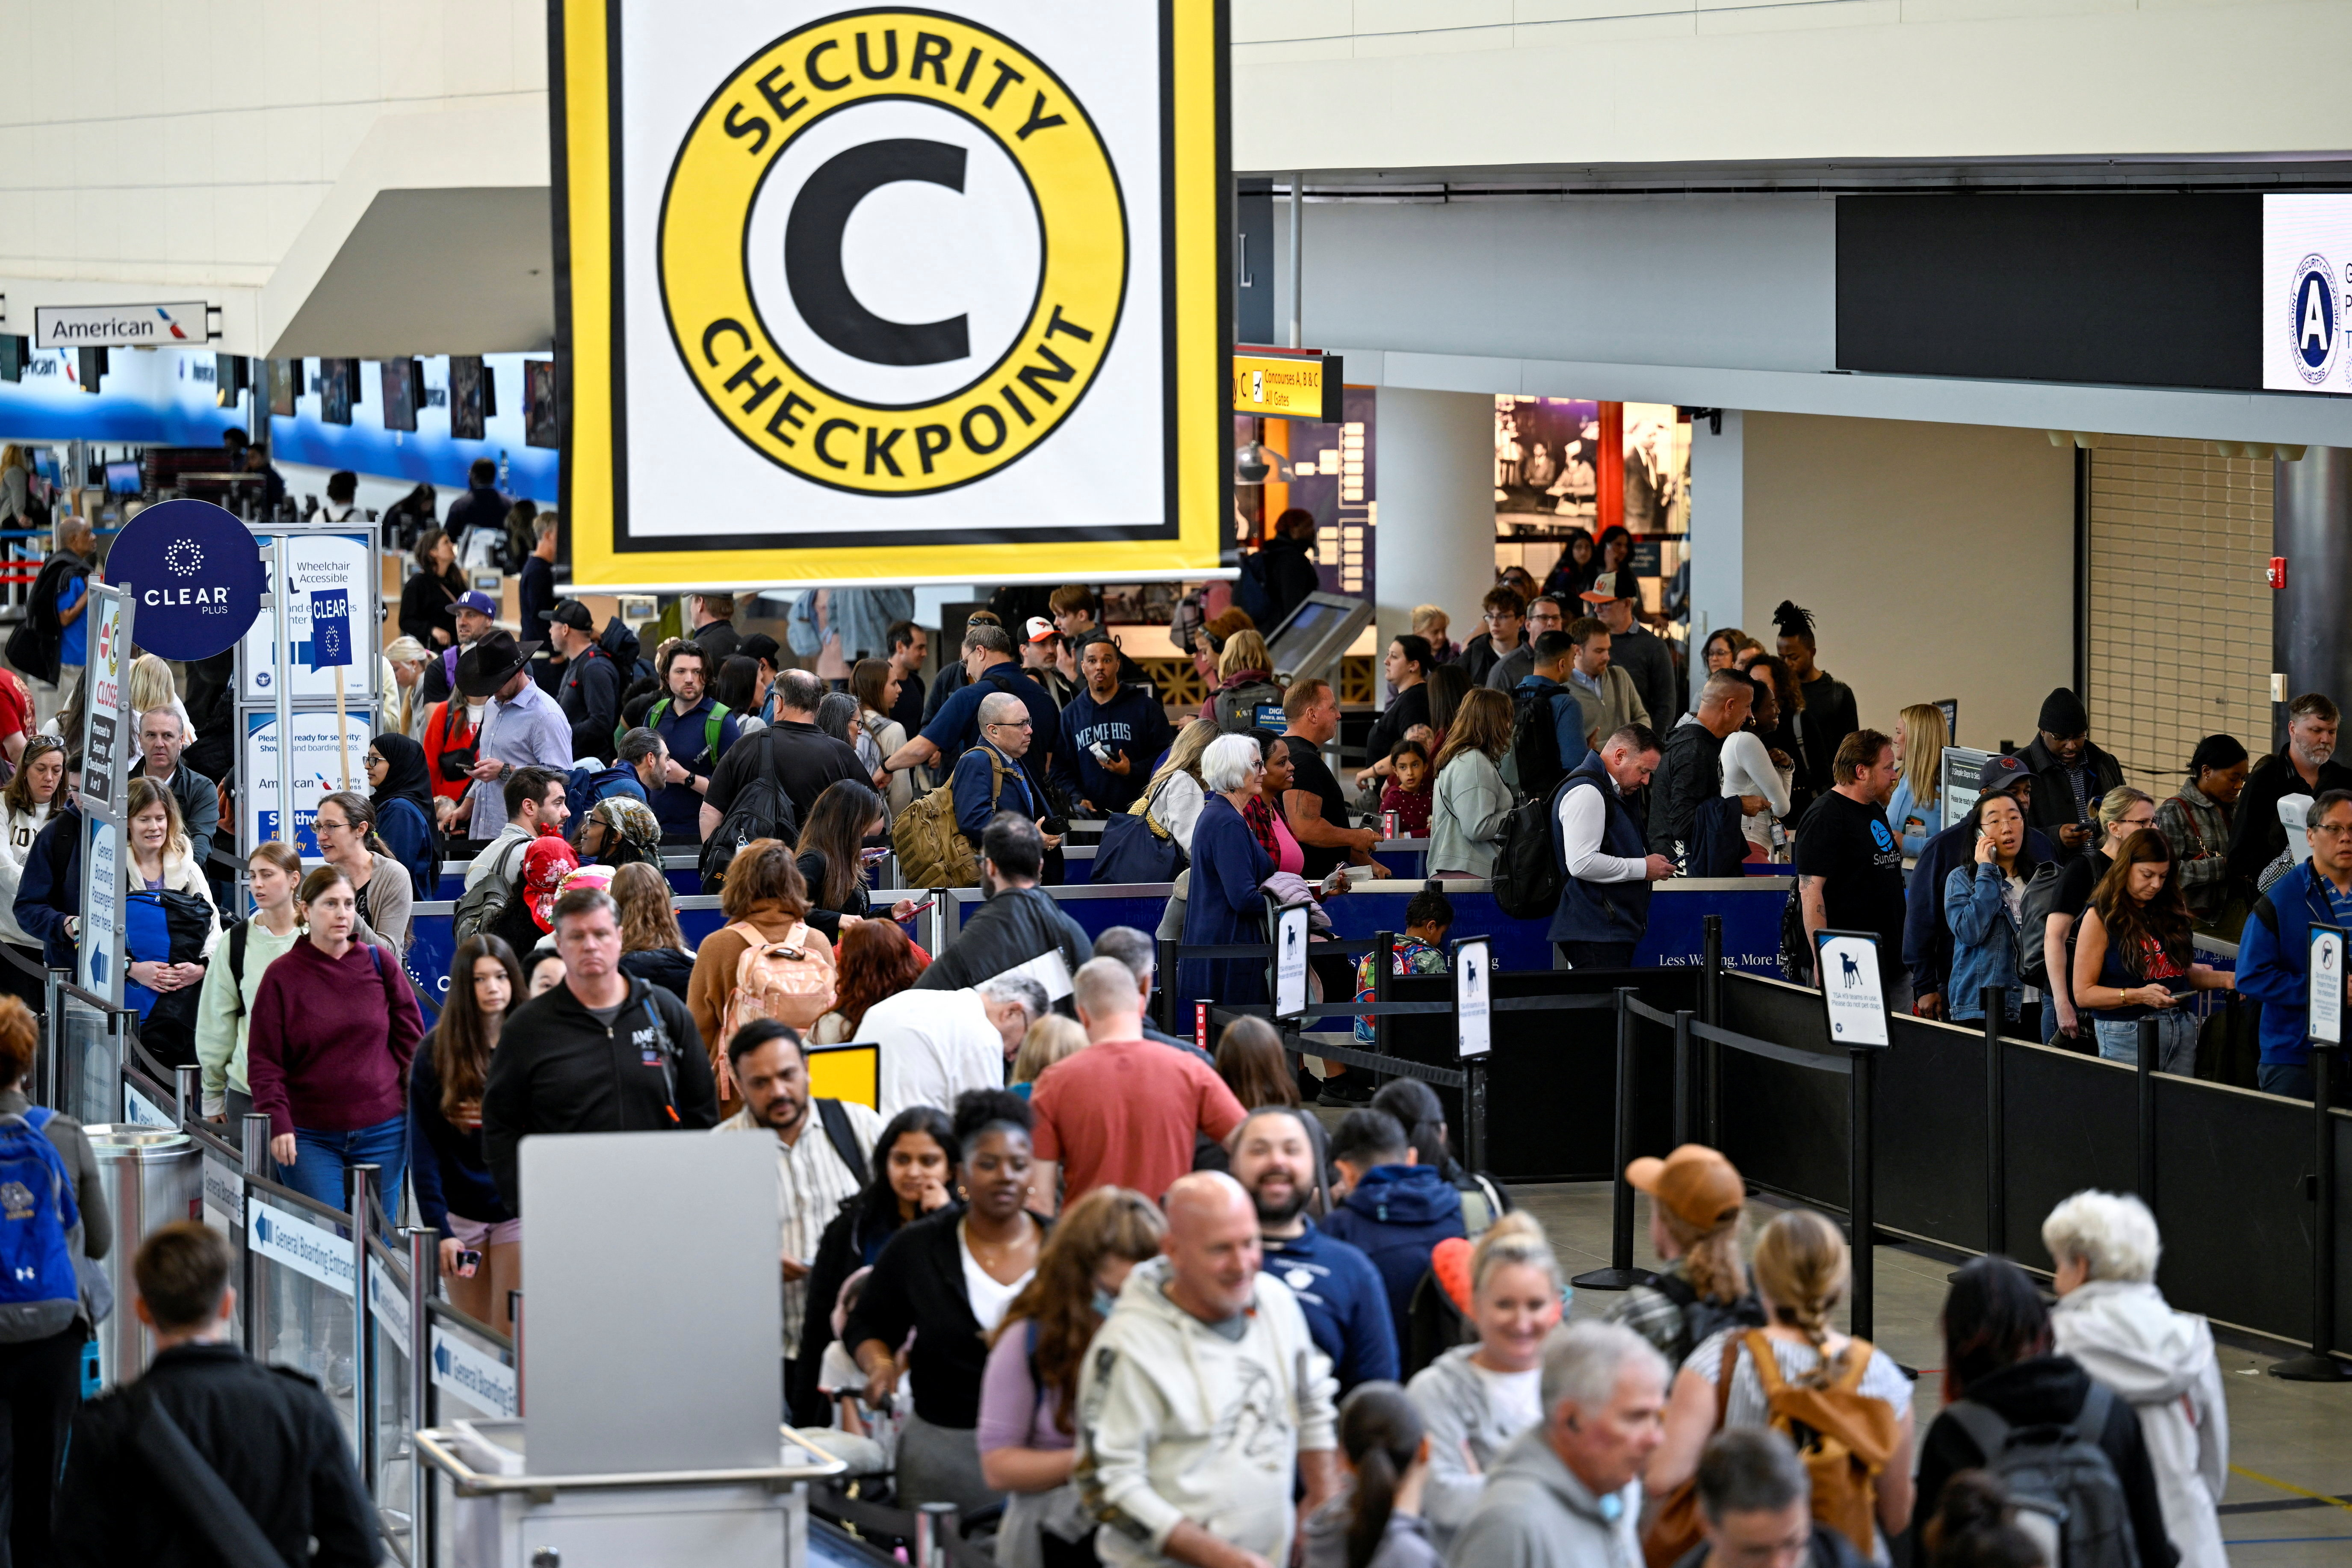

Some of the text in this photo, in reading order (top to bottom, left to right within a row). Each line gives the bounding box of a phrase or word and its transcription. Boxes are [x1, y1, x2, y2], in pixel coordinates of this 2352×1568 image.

[722, 29, 1067, 156] SECURITY
[784, 137, 971, 366] C
[2299, 258, 2338, 334] SECURITY CHECKPOINT
[2300, 280, 2328, 350] A
[53, 317, 154, 339] American
[2290, 289, 2302, 365] CHECKPOINT
[1241, 372, 1247, 397] C
[1265, 369, 1318, 387] Concourses A, B & C
[701, 304, 1094, 477] CHECKPOINT
[1274, 392, 1289, 407] Gates
[297, 561, 350, 571] Wheelchair
[300, 573, 348, 583] Accessible
[461, 591, 471, 602] N
[313, 599, 347, 619] CLEAR
[290, 615, 307, 624] nter
[97, 680, 118, 709] CLOSE
[92, 721, 110, 738] Proceed to
[295, 734, 316, 742] ready
[330, 733, 361, 741] secrity:
[92, 740, 107, 759] Security
[308, 744, 340, 753] boarding
[87, 757, 107, 775] Checkpoints
[1954, 768, 1963, 777] Simple
[90, 777, 100, 791] A or B
[259, 779, 314, 788] Amcan
[1963, 797, 1971, 806] ready
[98, 841, 114, 862] General
[95, 864, 113, 890] Boarding
[92, 886, 114, 911] Passengers
[91, 912, 112, 932] enter here.
[1660, 954, 1685, 966] Less
[1741, 954, 1772, 965] More
[206, 1170, 222, 1198] General
[222, 1181, 241, 1218] Boarding
[276, 1225, 355, 1282] General Boarding Entranc
[454, 1355, 479, 1390] General
[479, 1368, 508, 1416] Boarding
